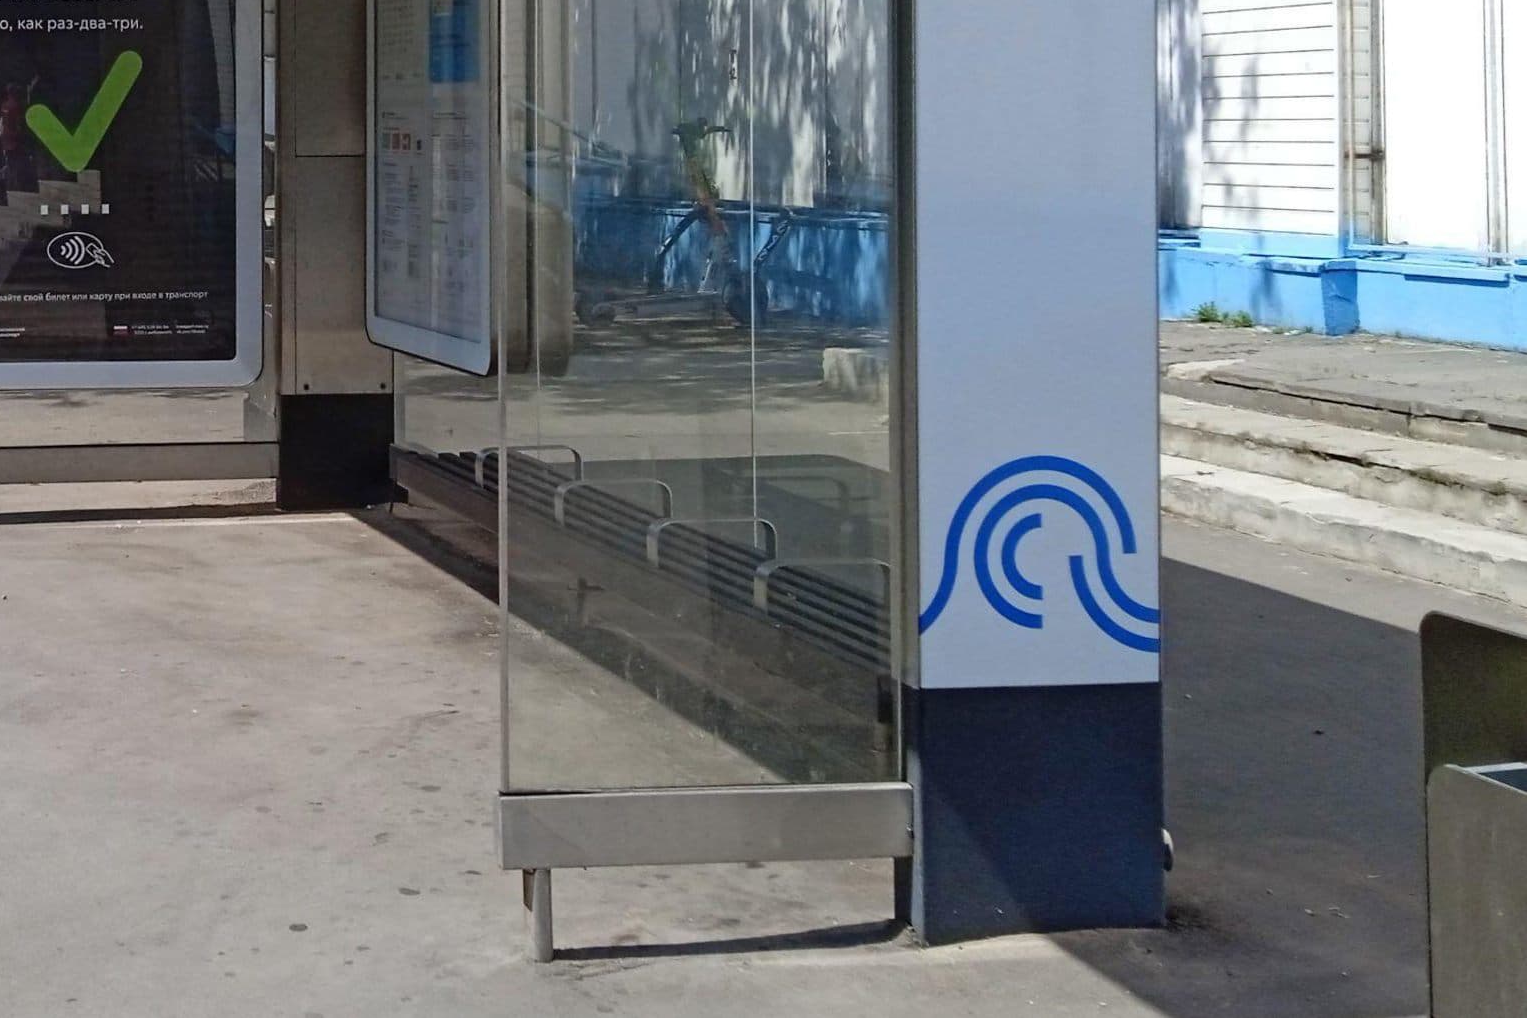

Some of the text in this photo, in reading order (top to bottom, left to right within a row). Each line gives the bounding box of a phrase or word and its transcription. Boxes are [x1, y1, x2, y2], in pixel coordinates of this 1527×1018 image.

[18, 19, 43, 30] как
[47, 18, 144, 32] раз-два-три.
[114, 293, 130, 301] при
